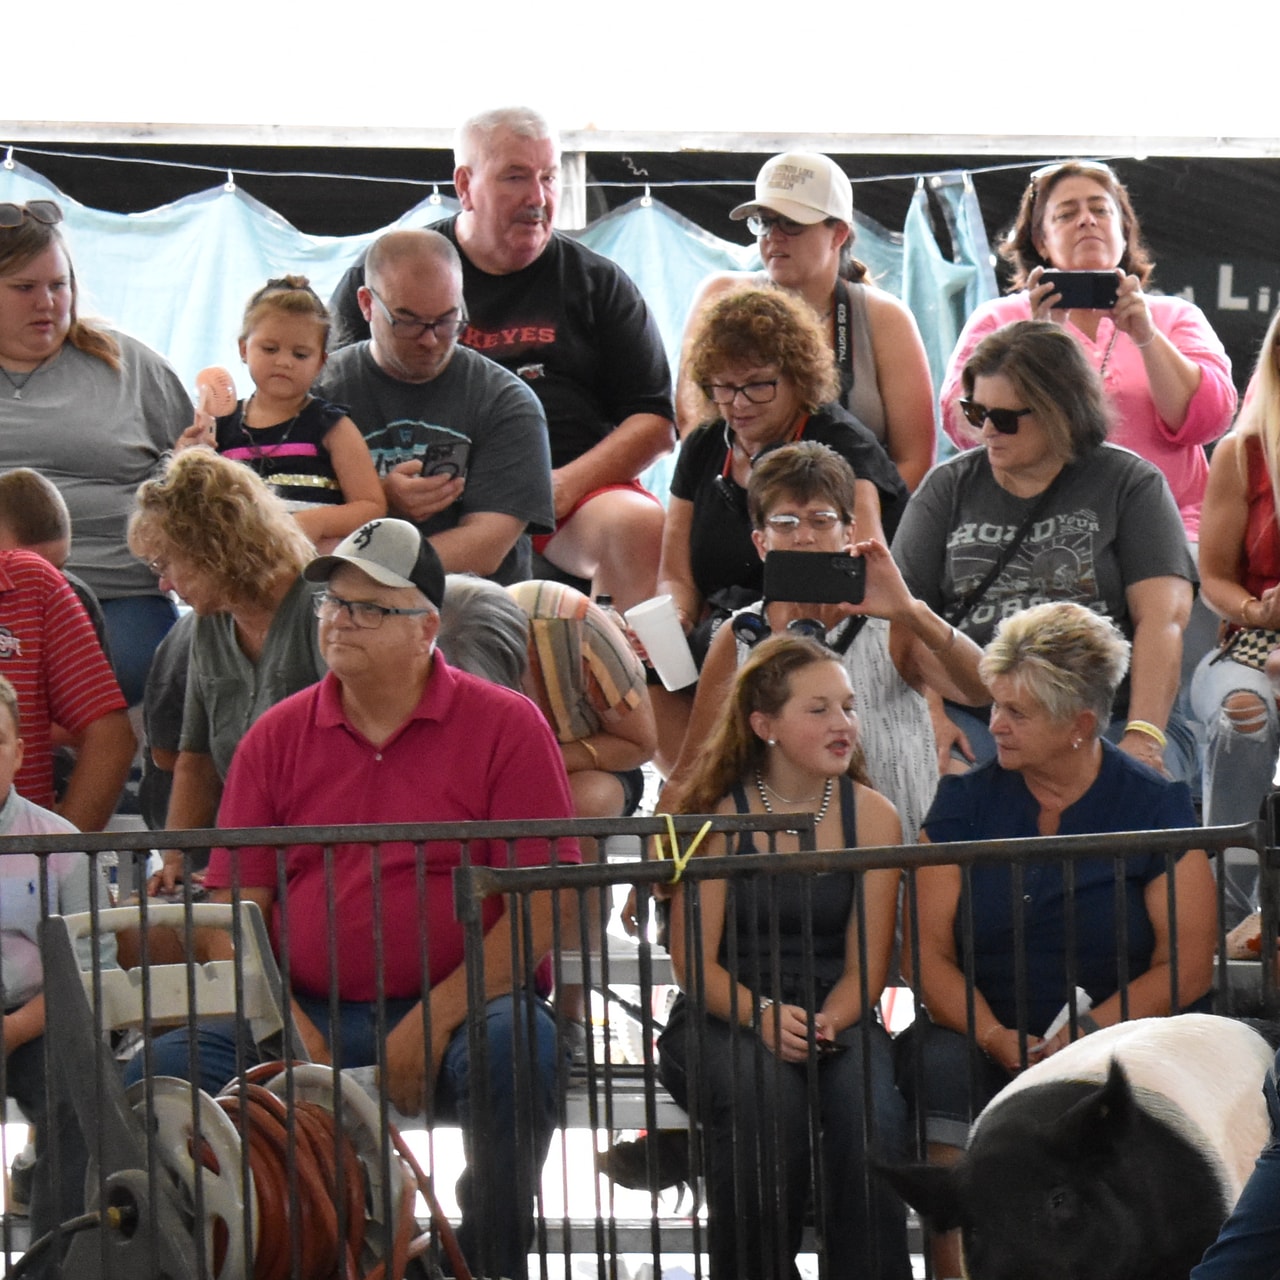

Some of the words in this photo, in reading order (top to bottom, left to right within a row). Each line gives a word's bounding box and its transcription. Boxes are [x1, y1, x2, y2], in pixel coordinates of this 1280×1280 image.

[837, 303, 847, 324] EOS
[459, 326, 556, 349] KEYES
[838, 325, 847, 363] DIGITAL
[1058, 513, 1101, 533] YOUR
